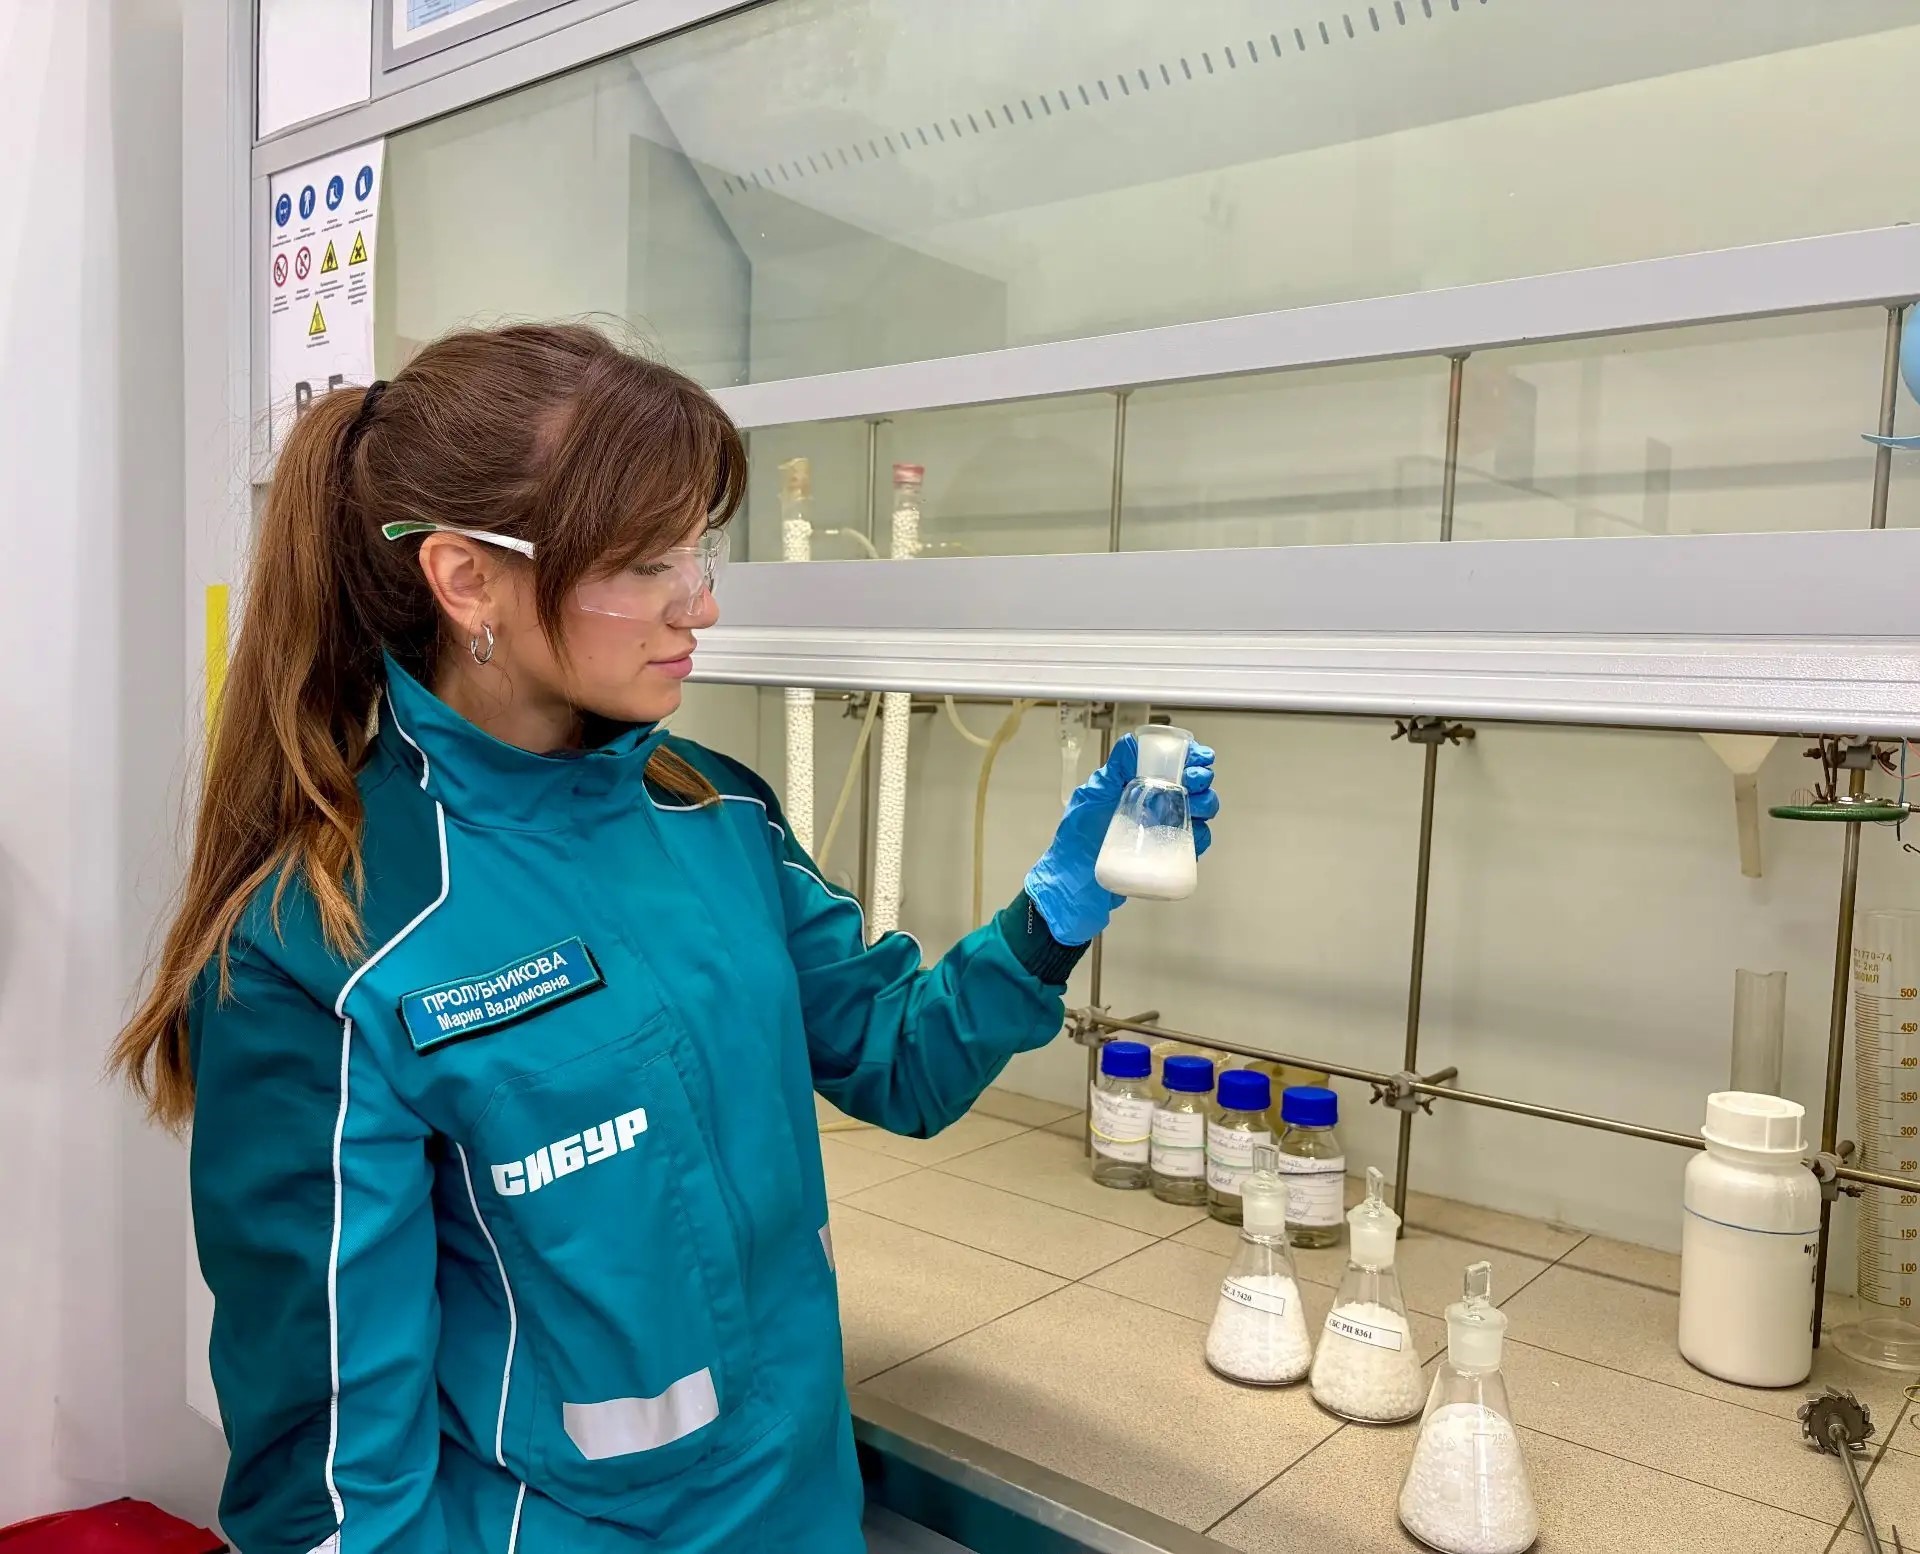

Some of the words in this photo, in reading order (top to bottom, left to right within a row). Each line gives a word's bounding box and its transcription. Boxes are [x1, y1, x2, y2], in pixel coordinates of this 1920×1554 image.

[421, 951, 568, 1014] ПРОЛУБНИКОВА
[1900, 988, 1918, 998] 500
[436, 1007, 484, 1031] Мария
[484, 974, 570, 1018] Вадимовна
[1900, 1023, 1918, 1032] 450
[1900, 1057, 1918, 1067] 400
[1900, 1092, 1918, 1102] 350
[1900, 1127, 1918, 1136] 300
[490, 1107, 648, 1196] СИБУР
[1900, 1161, 1917, 1170] 250
[1900, 1196, 1917, 1204] 200
[1901, 1230, 1917, 1238] 150
[1901, 1263, 1917, 1272] 100
[1900, 1297, 1911, 1307] 50
[1354, 1327, 1373, 1340] 8361
